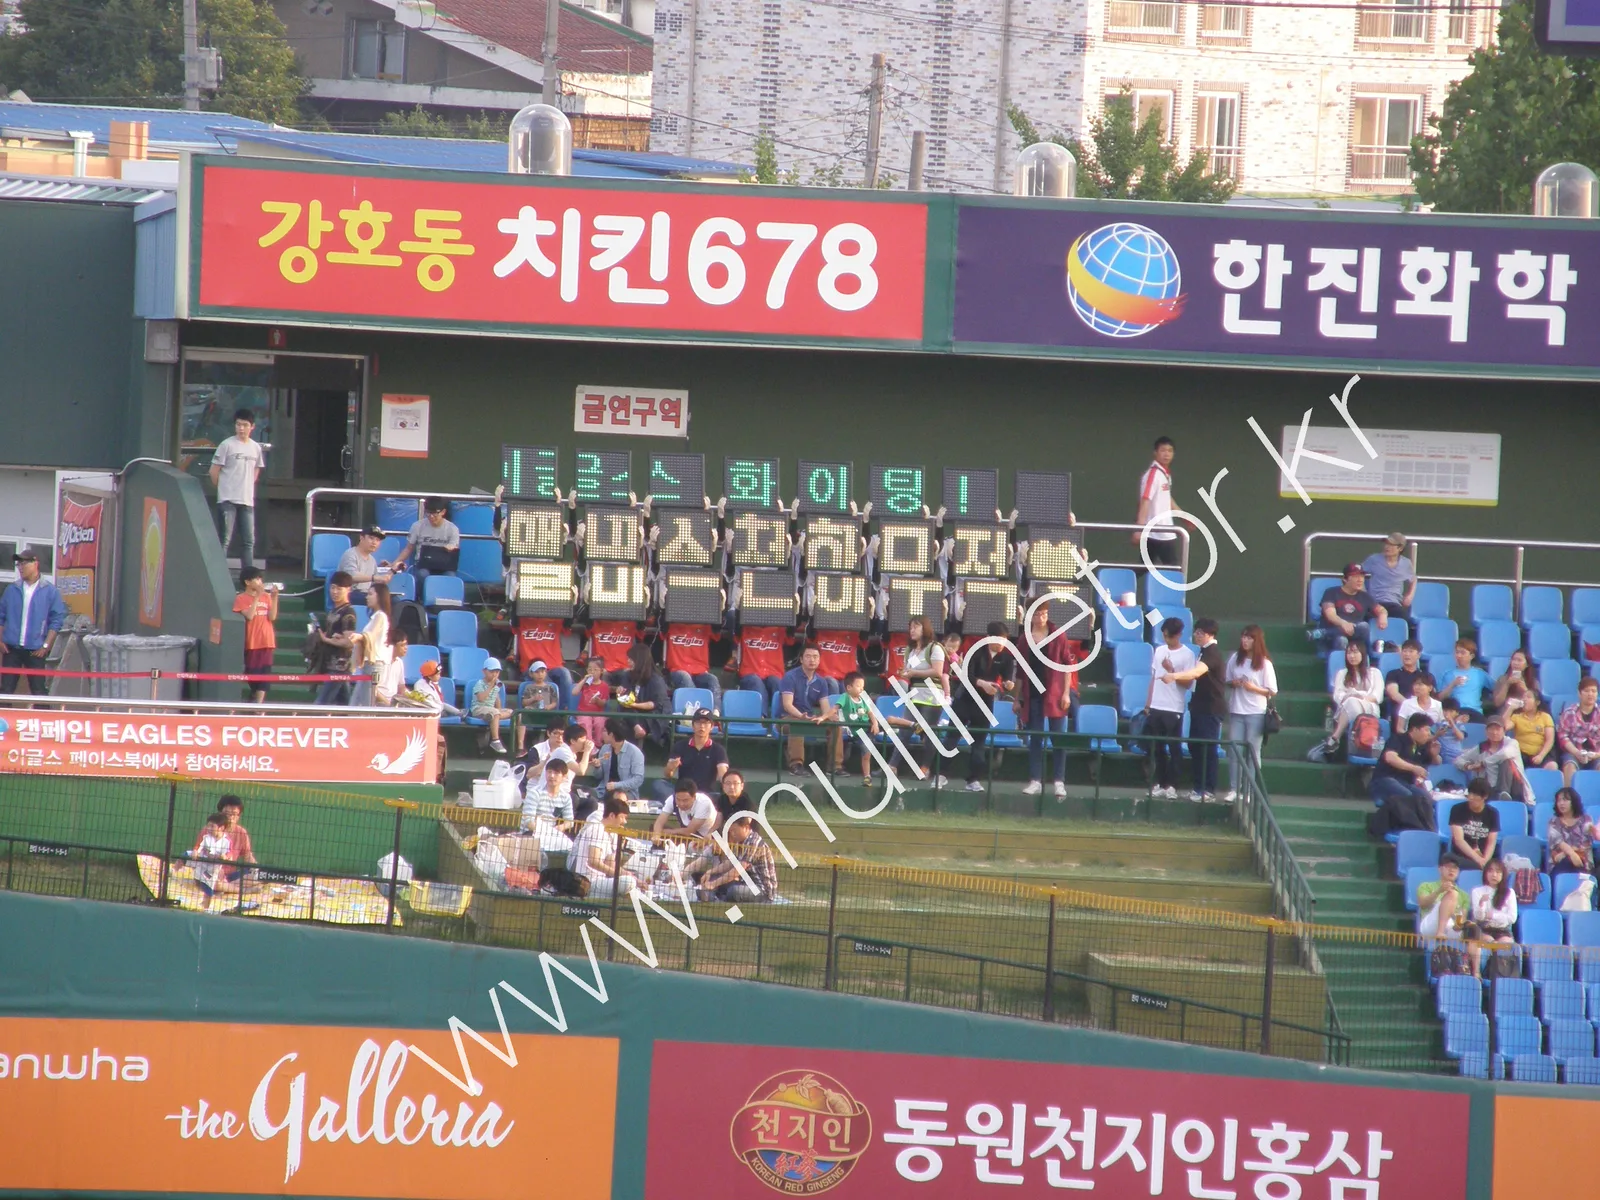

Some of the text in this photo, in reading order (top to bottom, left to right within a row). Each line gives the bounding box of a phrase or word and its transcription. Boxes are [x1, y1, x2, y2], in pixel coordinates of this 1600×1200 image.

[258, 199, 476, 292] 강호동
[1213, 239, 1578, 346] 한진화학
[582, 393, 682, 429] 금연구역
[15, 718, 350, 749] 캠페인 EAGLES FOREVER
[68, 750, 179, 771] 페이스북에서
[184, 752, 280, 773] 참여하세요.
[164, 1098, 245, 1139] the
[750, 1109, 852, 1153] 천지인
[750, 1157, 846, 1192] KOREAN RED GINSENG
